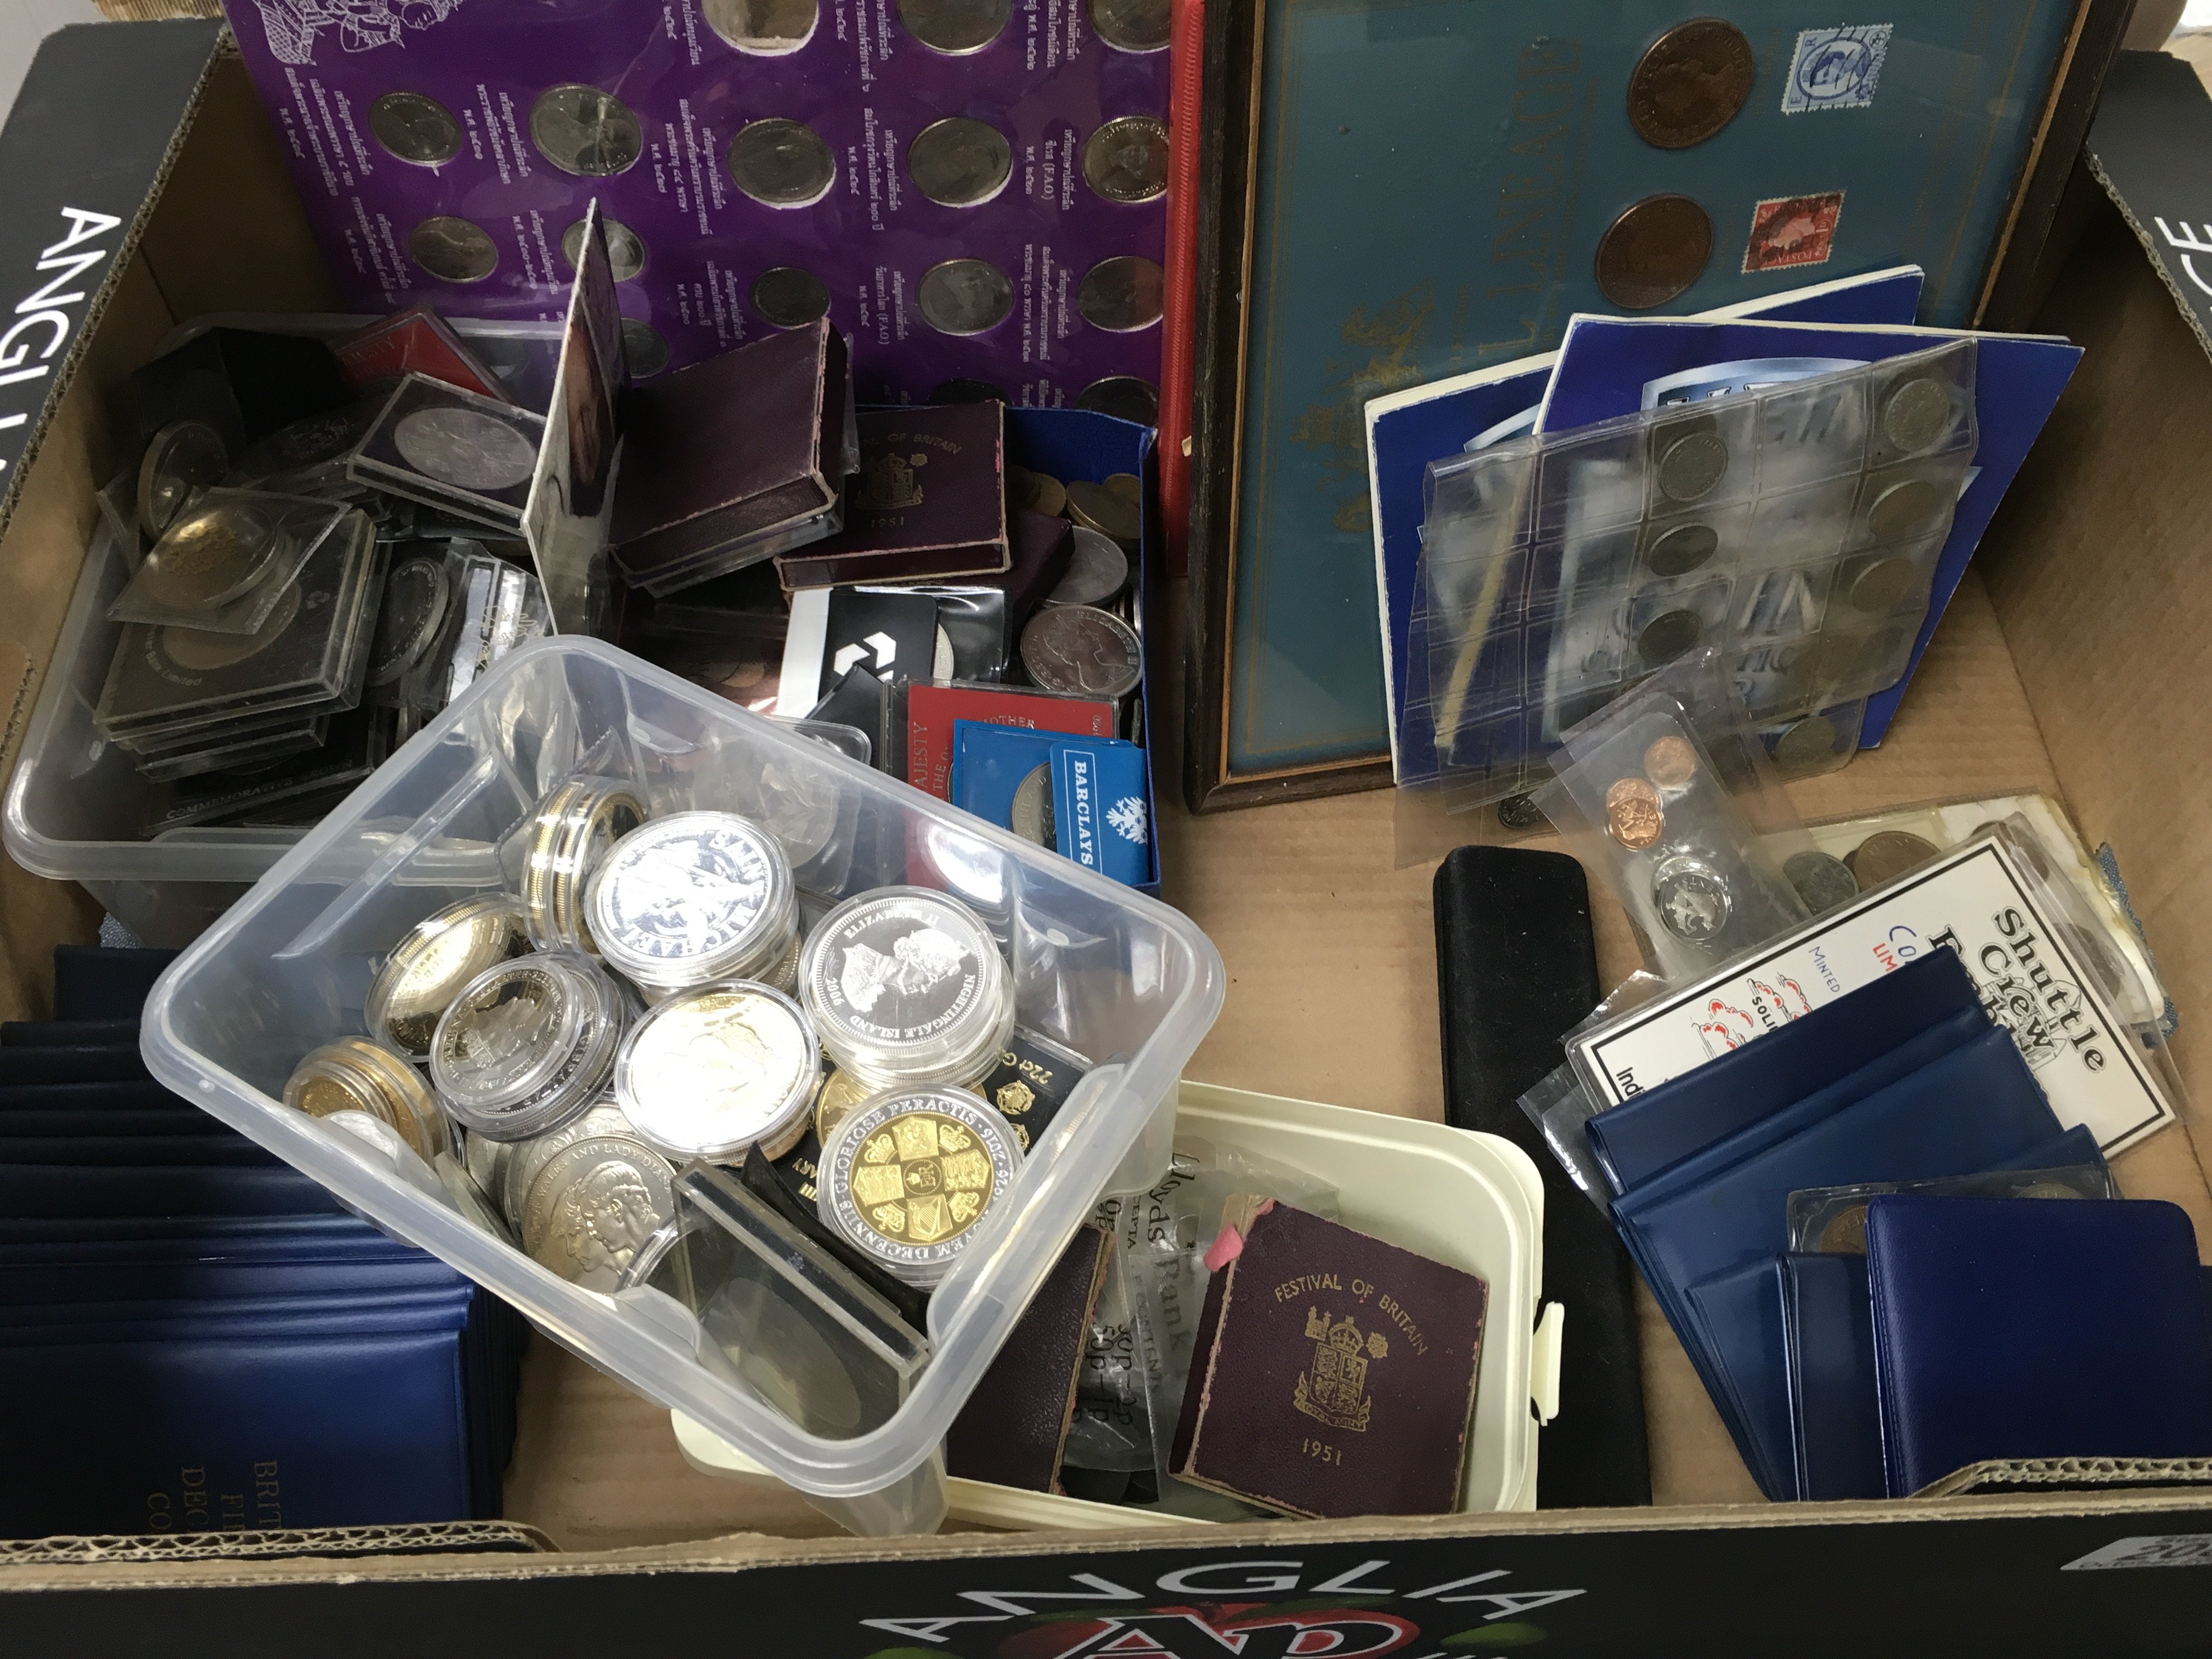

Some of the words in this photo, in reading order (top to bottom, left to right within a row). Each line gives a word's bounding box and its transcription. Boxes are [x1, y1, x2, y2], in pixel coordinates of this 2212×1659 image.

[913, 434, 962, 455] BRITAIN
[870, 517, 905, 528] 1951
[913, 720, 928, 791] AJESTY
[1073, 760, 1094, 866] BARCLAYS
[843, 907, 924, 940] ELIZABETH
[825, 977, 844, 1006] 2006
[1808, 944, 1839, 993] MINTED
[1978, 942, 2056, 1050] Crew
[1995, 907, 2107, 1072] Shuttle
[849, 1014, 900, 1040] ISLAND
[904, 973, 976, 1040] NIGHTINGALE
[836, 1108, 884, 1193] GLORIOSE
[888, 1098, 978, 1124] PERACTIS
[980, 1128, 1006, 1161] 2015
[539, 1161, 568, 1197] WALES
[572, 1144, 599, 1161] AND
[603, 1143, 641, 1160] LADY
[839, 1201, 929, 1260] DECENNIIS
[1274, 1273, 1342, 1302] FESTIVAL
[1351, 1279, 1374, 1299] OF
[1379, 1295, 1429, 1356] BRITAIN
[1301, 1437, 1342, 1466] 1951
[858, 1557, 1589, 1644] ANGLIA
